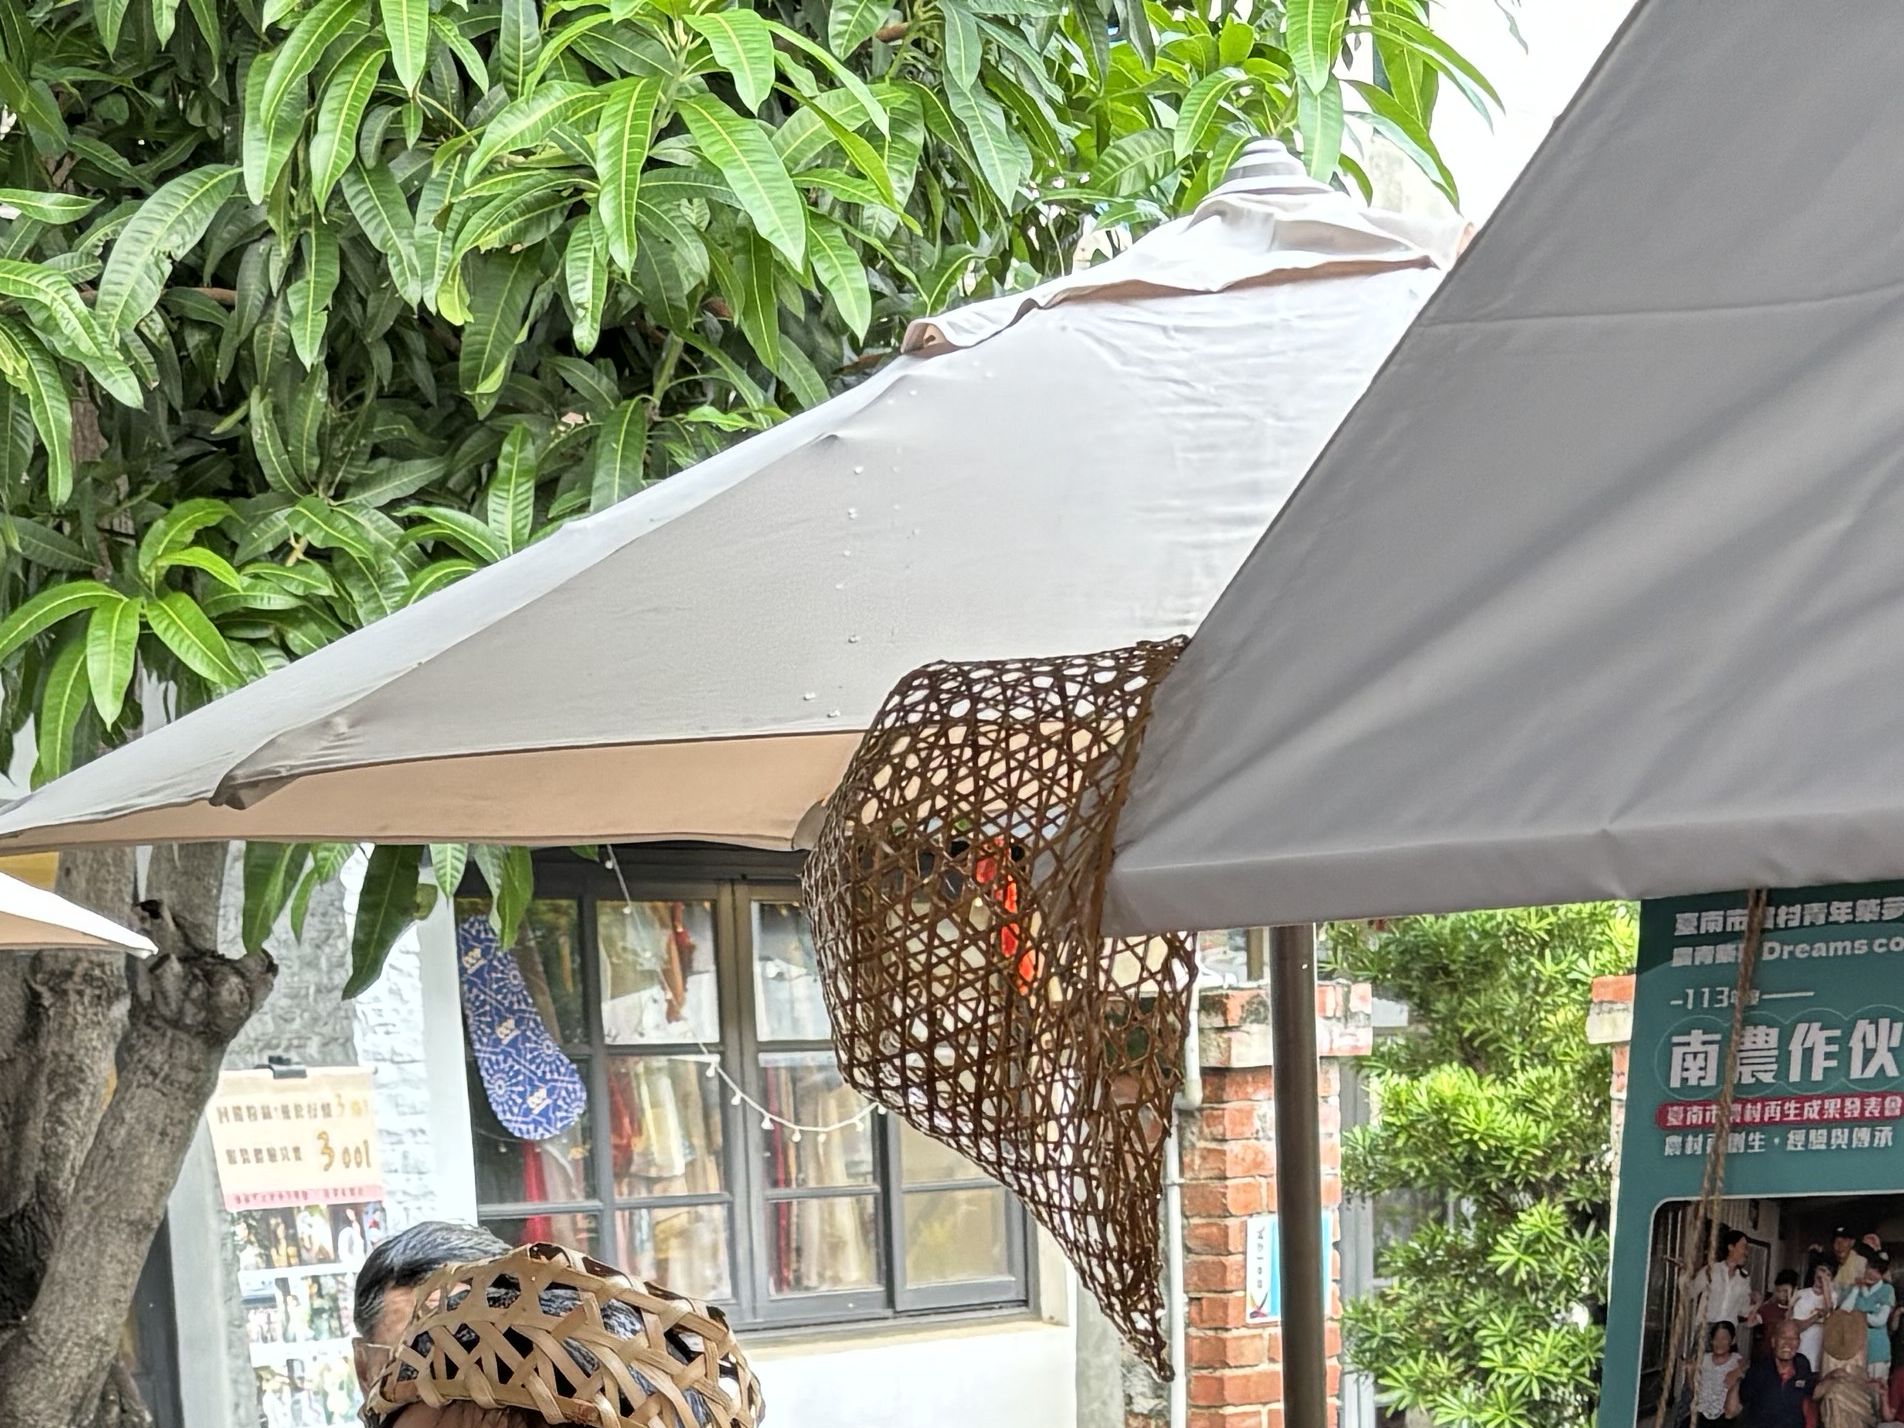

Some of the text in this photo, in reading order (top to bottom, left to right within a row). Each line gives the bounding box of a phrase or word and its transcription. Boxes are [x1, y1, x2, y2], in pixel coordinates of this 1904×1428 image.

[1763, 938, 1868, 961] Dreams
[1669, 1017, 1904, 1088] 南農作伙
